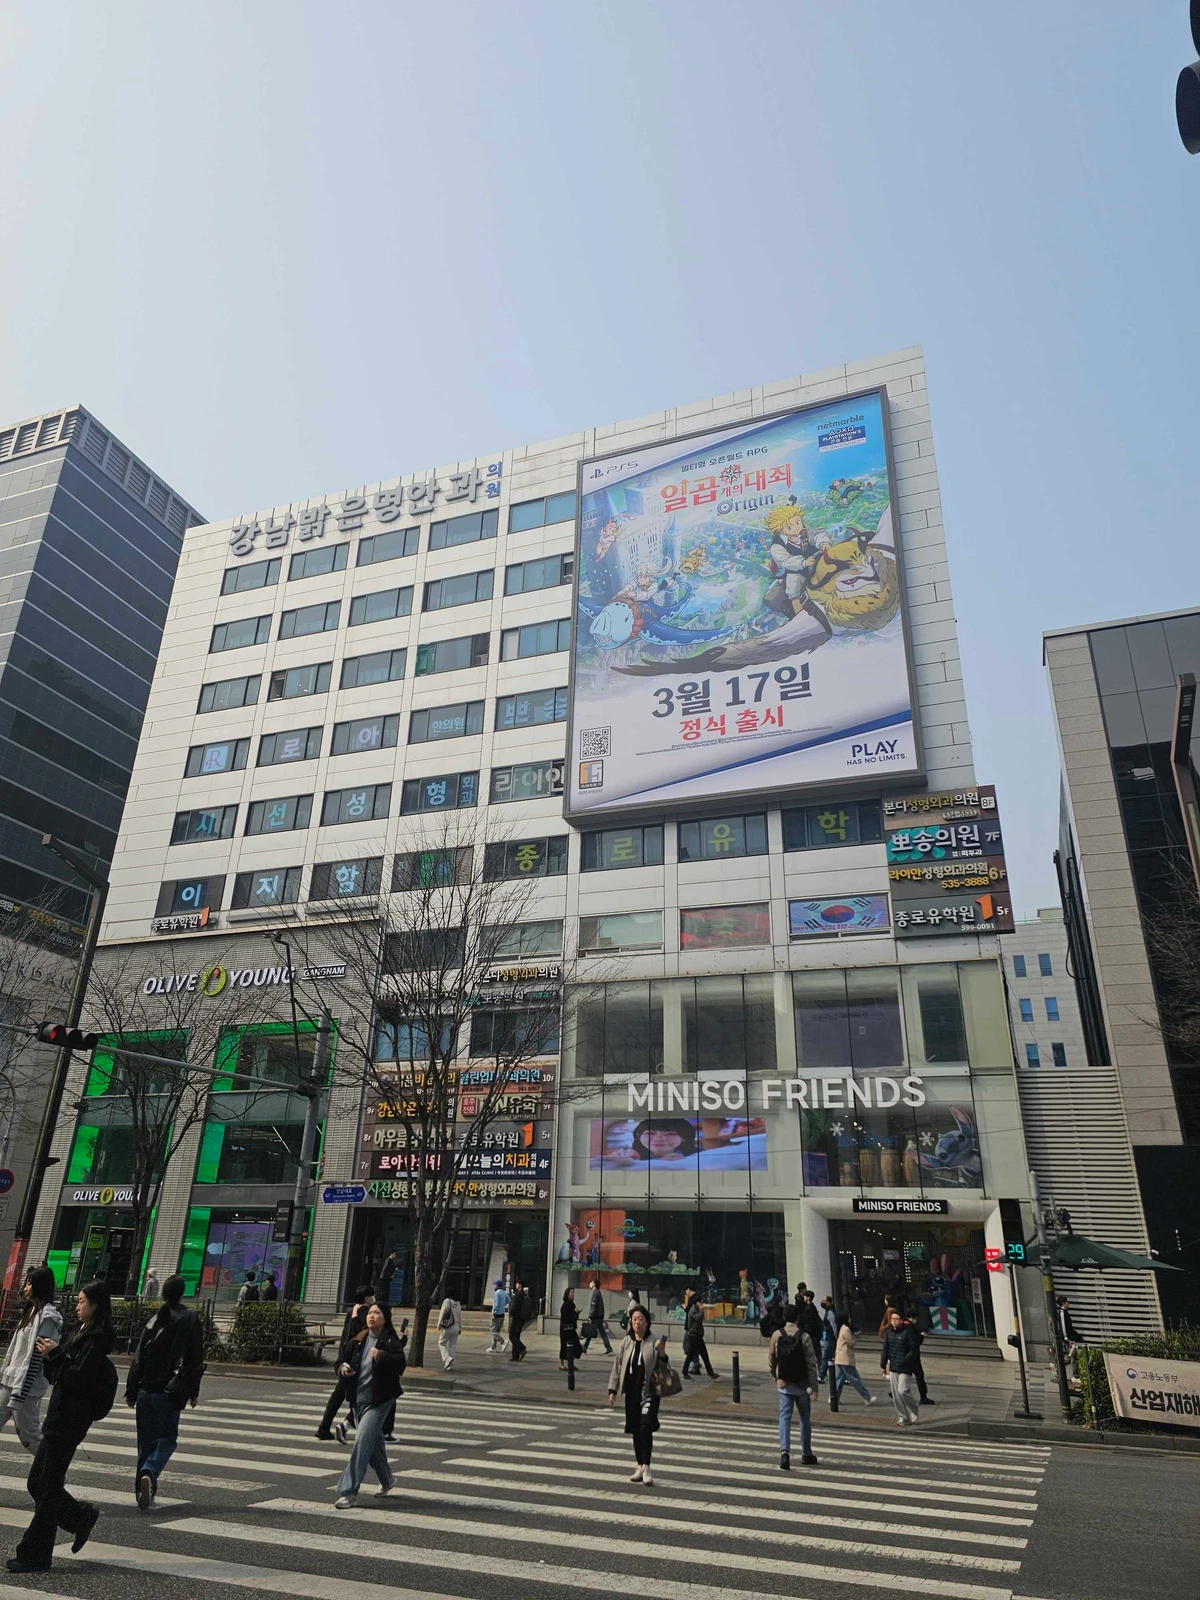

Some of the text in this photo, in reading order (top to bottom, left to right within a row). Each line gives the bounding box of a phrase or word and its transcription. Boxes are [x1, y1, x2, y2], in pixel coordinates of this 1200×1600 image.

[817, 415, 865, 430] netmarble
[709, 452, 743, 466] 오픈월드
[747, 446, 768, 458] RPG
[606, 460, 640, 475] PS5
[660, 463, 792, 513] 일곱 개의 대죄
[228, 461, 503, 557] 강남밝은명안과 의원
[716, 494, 775, 516] Origin
[652, 662, 813, 718] 3월 17일
[432, 716, 464, 733] 한의원
[679, 705, 784, 741] 정식 출시
[851, 739, 898, 758] PLAY
[206, 749, 223, 769] R
[846, 758, 862, 766] HAS
[864, 756, 877, 764] NO
[981, 799, 994, 808] 8F
[891, 825, 1000, 852] 뽀송의원 7F
[889, 862, 1006, 881] 라이안성형외과의원 6F
[941, 877, 989, 889] 535-3888
[152, 915, 198, 931] 종로유학원
[895, 905, 975, 928] 종로유학원
[996, 906, 1010, 916] 5F
[303, 967, 346, 977] GANGNAM
[143, 966, 296, 995] OLIVE YOUNG
[627, 1077, 926, 1112] MINISO FRIENDS
[542, 1131, 551, 1139] 5F
[361, 1162, 369, 1170] 7F
[539, 1159, 550, 1169] 4F
[73, 1190, 141, 1201] OLIVE YOU
[539, 1189, 548, 1198] 6F
[858, 1201, 942, 1212] MINISO FRIENDS
[1008, 1243, 1024, 1259] 29
[1140, 1371, 1179, 1384] 고용노동부
[1130, 1388, 1200, 1416] 산업재해
